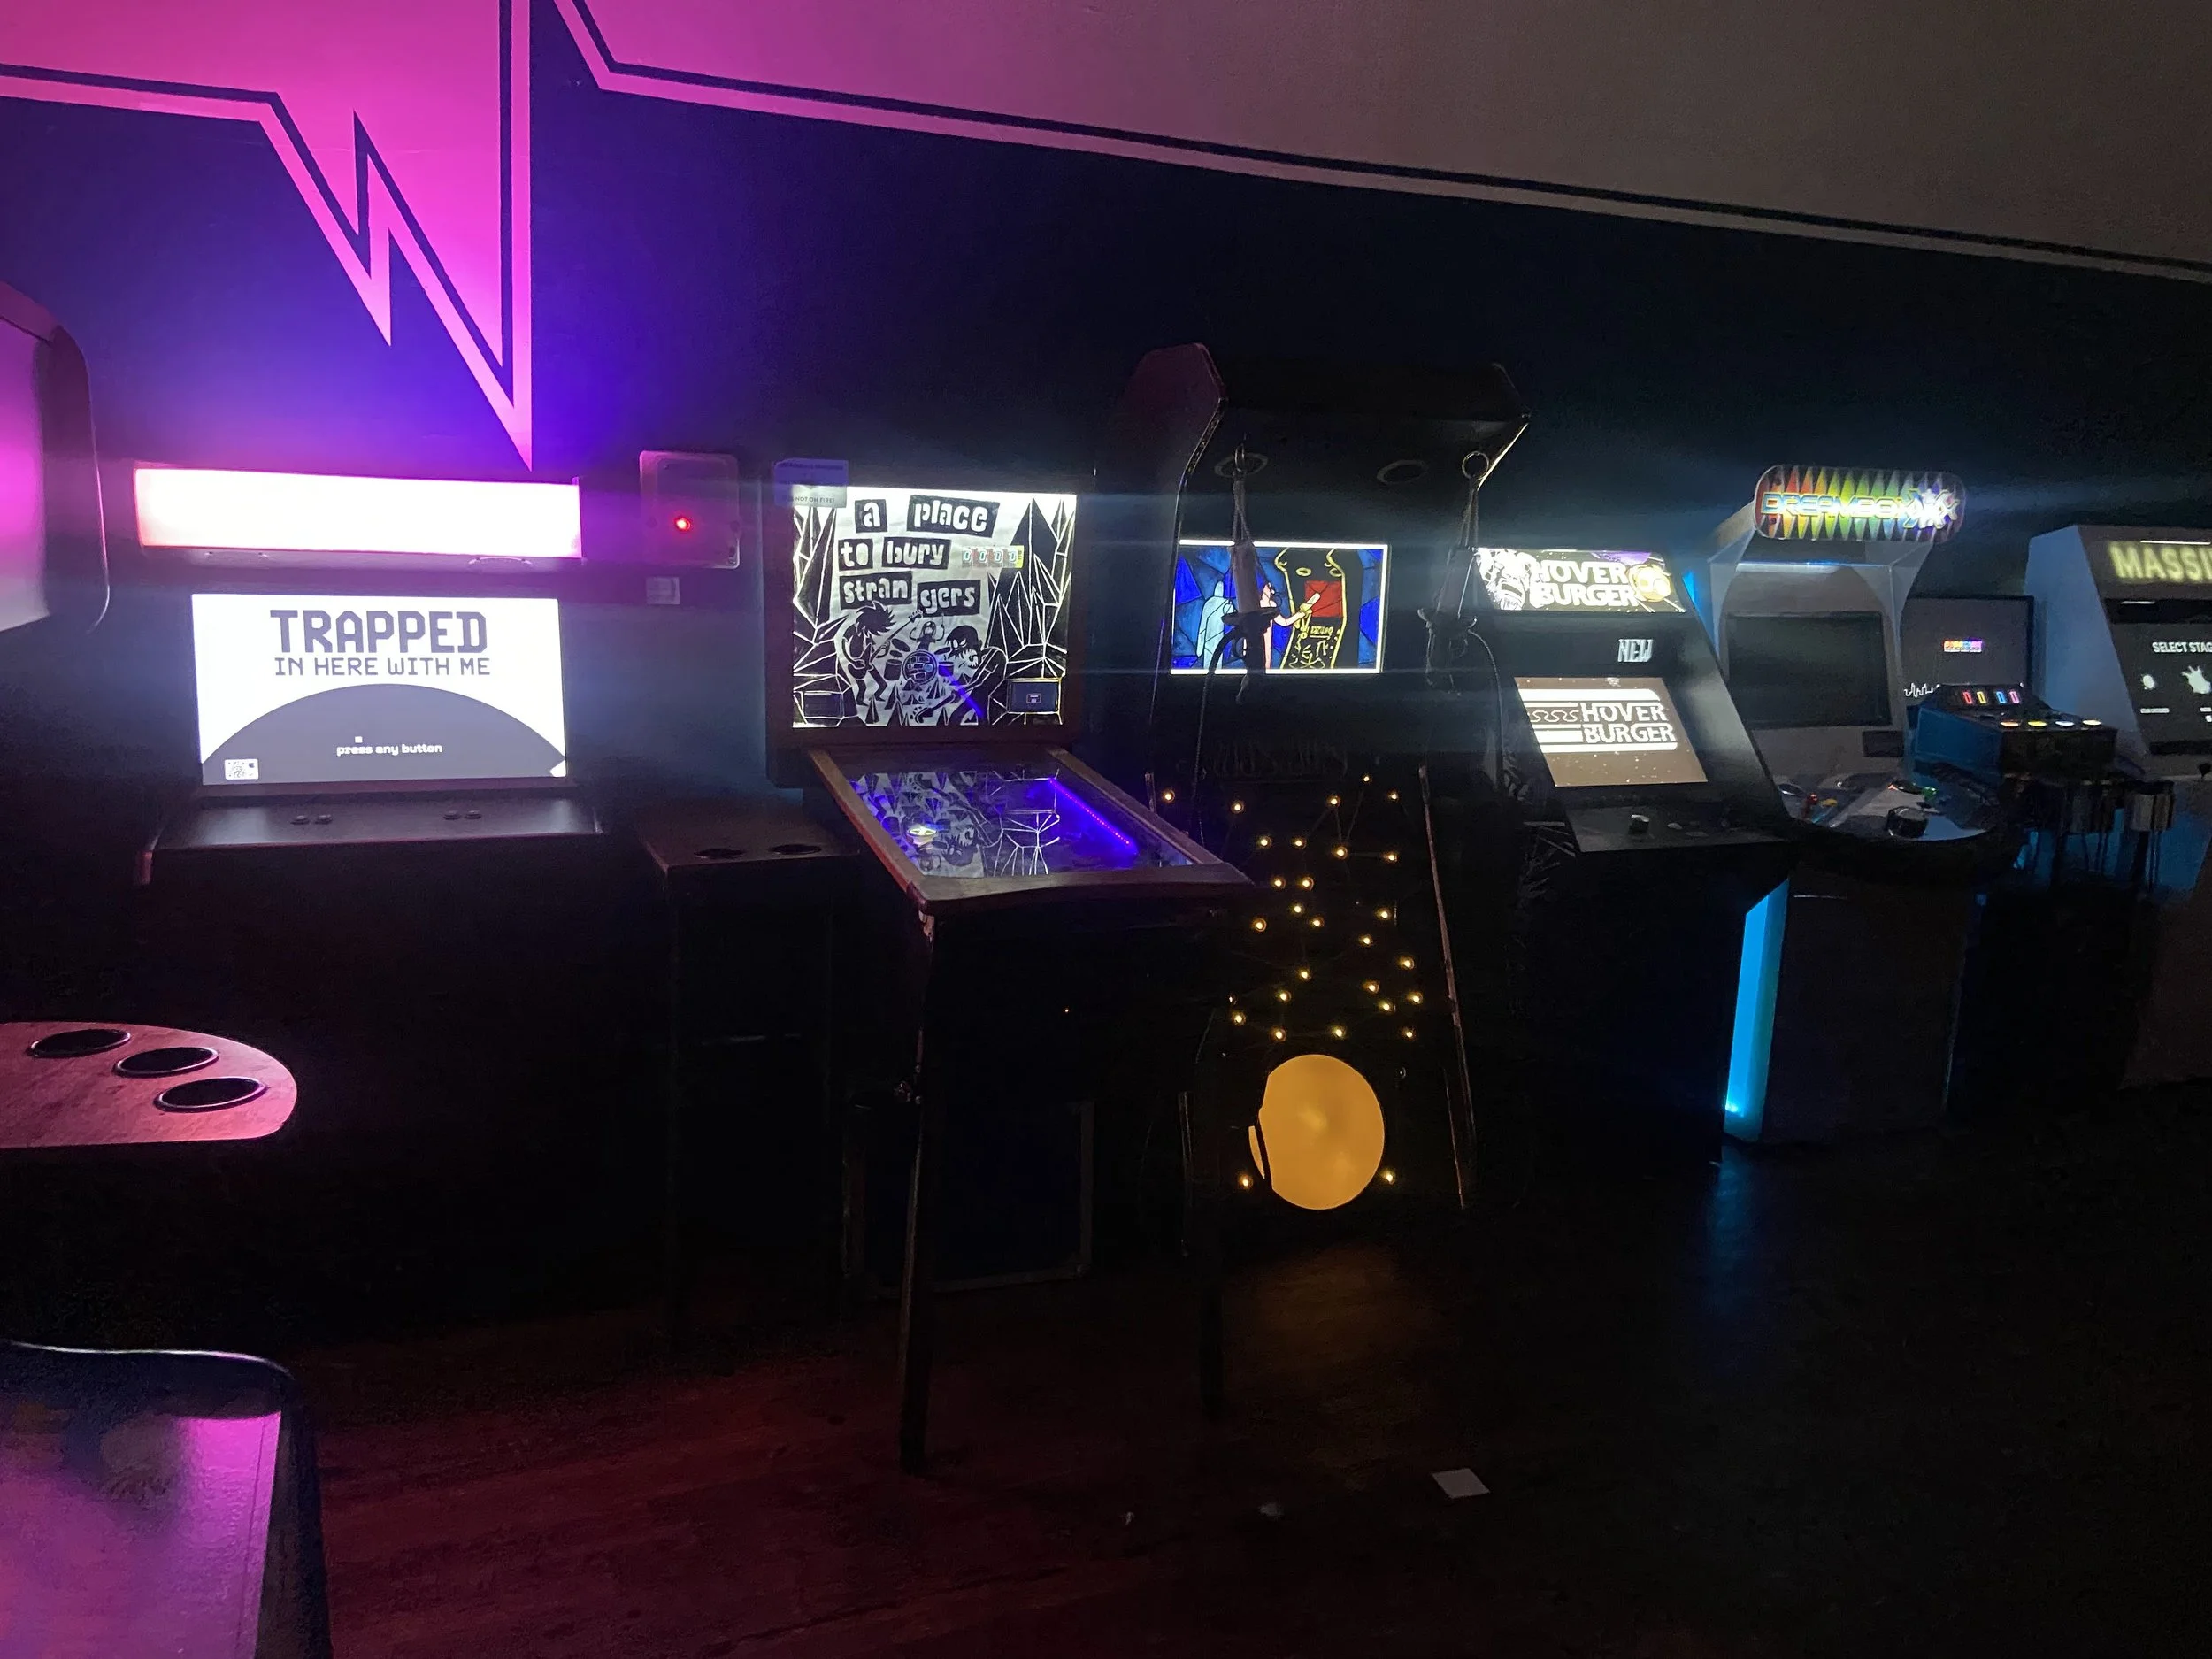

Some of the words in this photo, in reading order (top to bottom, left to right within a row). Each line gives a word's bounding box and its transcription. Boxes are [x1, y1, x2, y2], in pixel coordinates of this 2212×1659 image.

[862, 500, 882, 528] a
[912, 502, 989, 532] place
[841, 540, 869, 566] to
[887, 540, 945, 567] bury
[2109, 541, 2212, 581] MASSI
[1536, 560, 1630, 583] HOVER
[843, 577, 908, 603] stran
[920, 586, 976, 613] gers
[1535, 583, 1640, 606] BURGER
[270, 610, 488, 653] TRAPPED
[1617, 638, 1654, 663] NEW
[2152, 641, 2188, 653] SELECT
[274, 657, 303, 676] IN
[314, 657, 379, 676] HERE
[388, 657, 450, 676] WITH
[459, 657, 490, 676] ME
[1579, 702, 1670, 722] HOVER
[1582, 723, 1677, 743] BURGER
[336, 745, 373, 757] press
[375, 745, 399, 756] any
[401, 743, 443, 754] button
